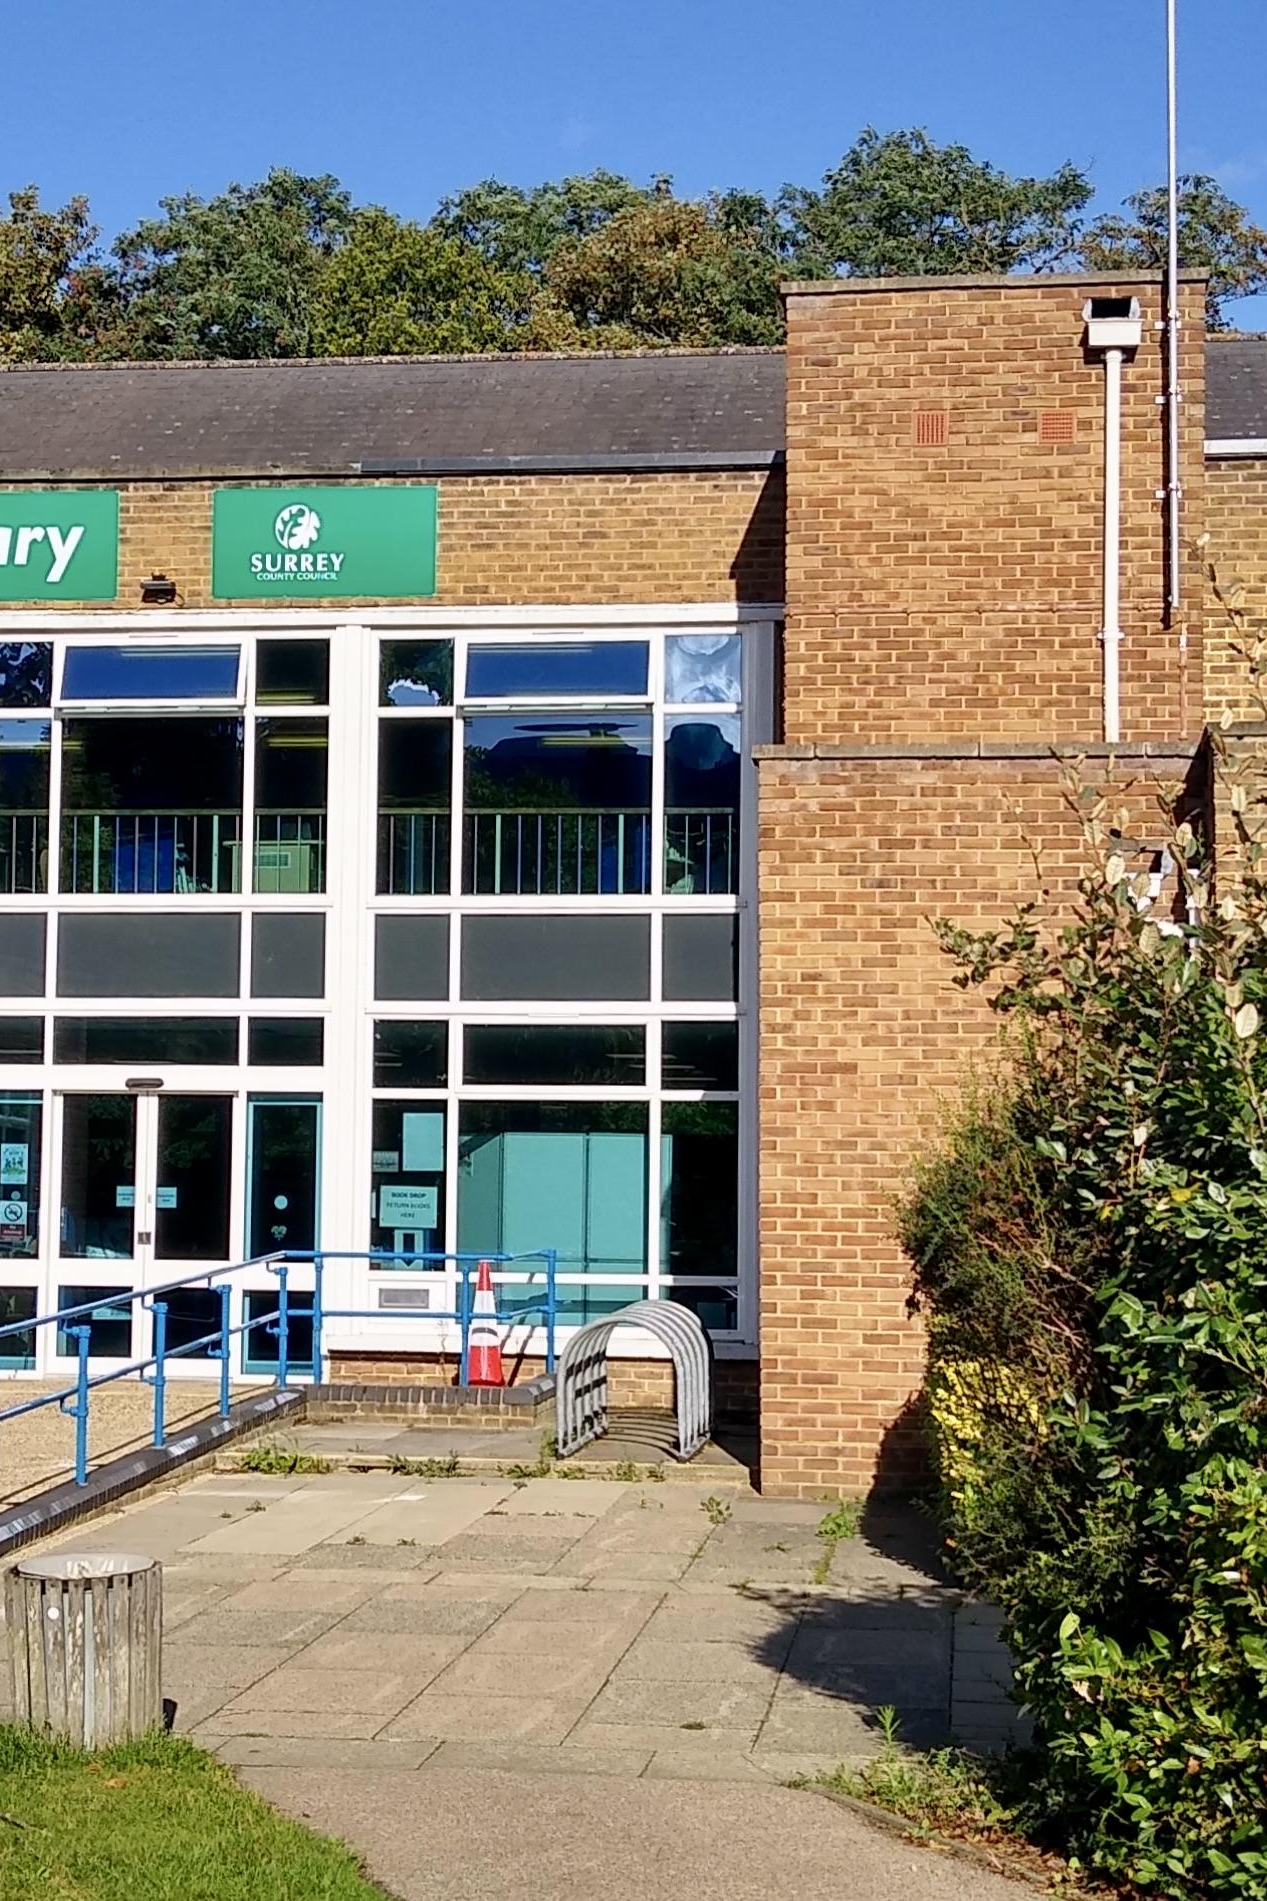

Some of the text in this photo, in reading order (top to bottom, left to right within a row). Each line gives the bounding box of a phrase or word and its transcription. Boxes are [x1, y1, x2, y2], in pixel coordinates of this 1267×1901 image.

[250, 552, 345, 572] SURREY
[256, 572, 338, 581] COUNTY COUNCIL
